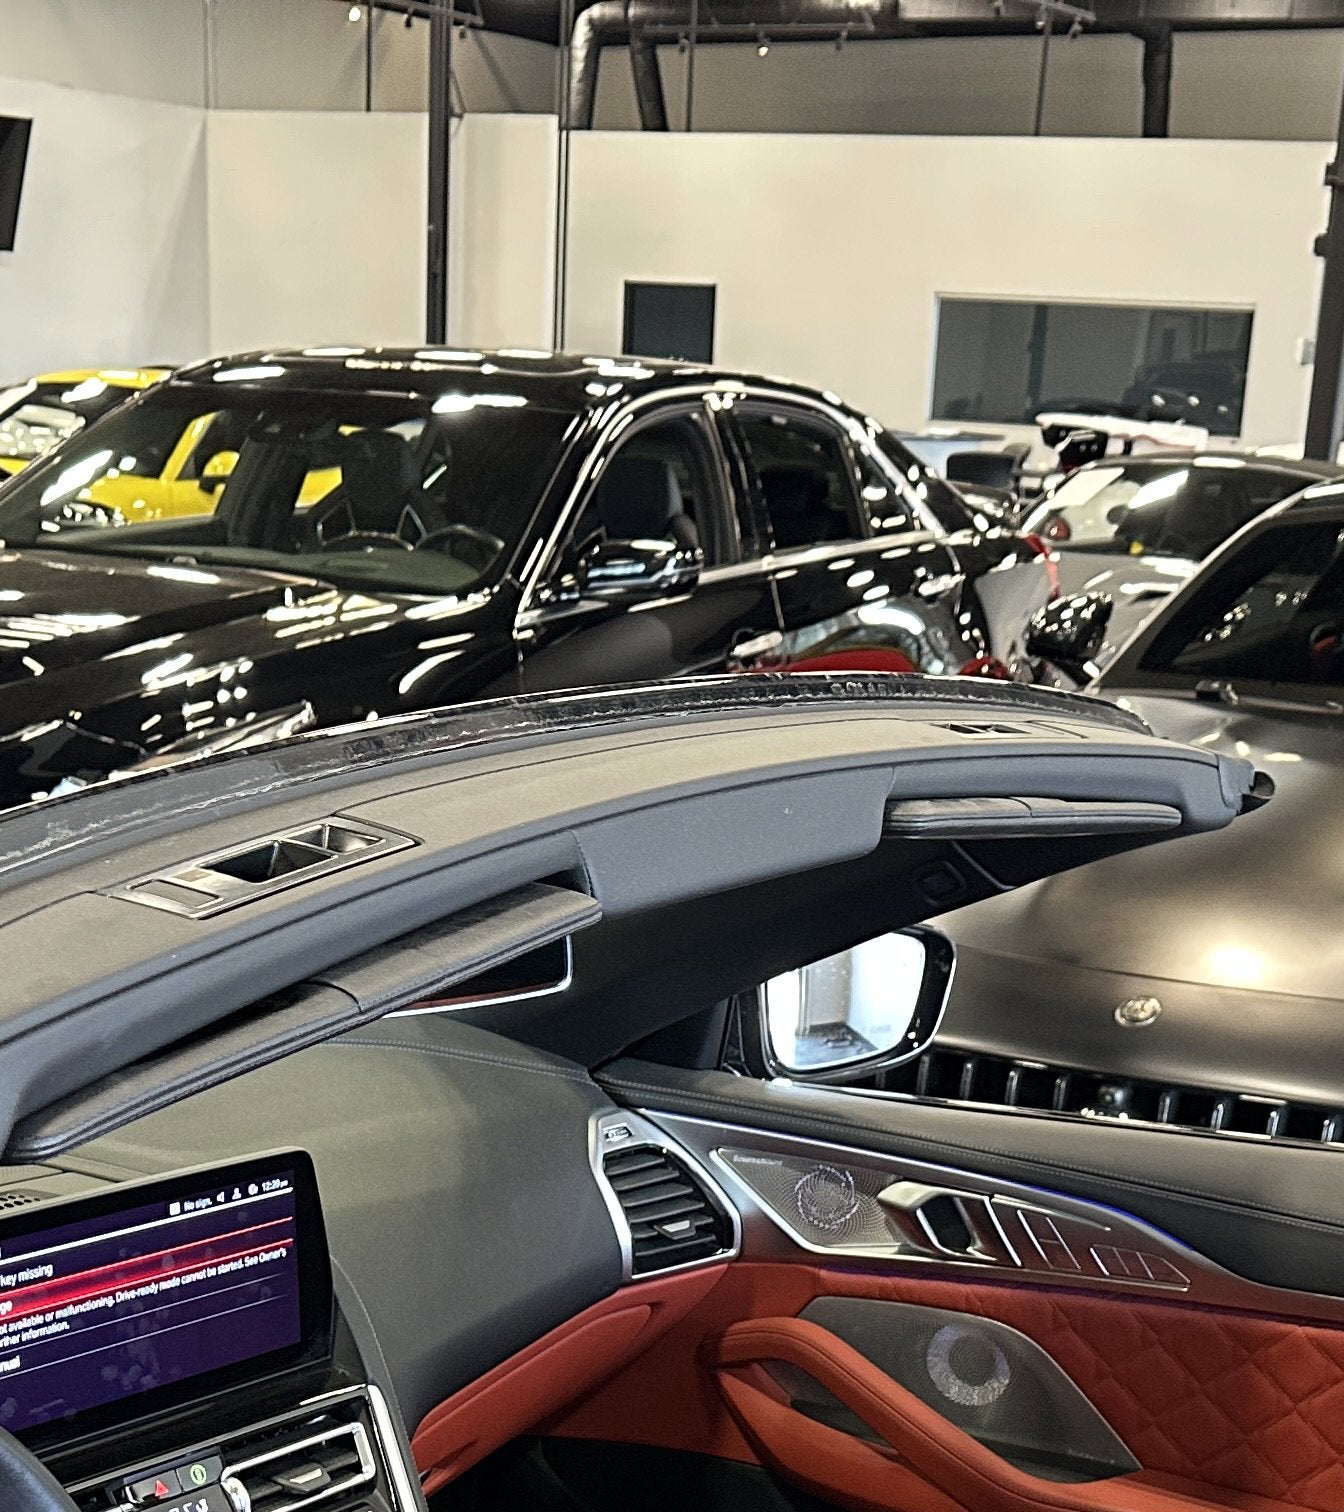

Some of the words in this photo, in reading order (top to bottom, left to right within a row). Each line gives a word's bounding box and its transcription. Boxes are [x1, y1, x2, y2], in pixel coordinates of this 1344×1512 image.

[0, 1272, 18, 1287] key
[18, 1264, 54, 1282] missing
[8, 1314, 45, 1332] available
[44, 1311, 55, 1322] or
[115, 1282, 159, 1304] Drive-ready
[159, 1276, 181, 1291] mode
[181, 1268, 207, 1285] cannot
[206, 1267, 217, 1278] be
[244, 1255, 259, 1268] See
[258, 1247, 288, 1264] Owner's
[21, 1320, 71, 1342] information.
